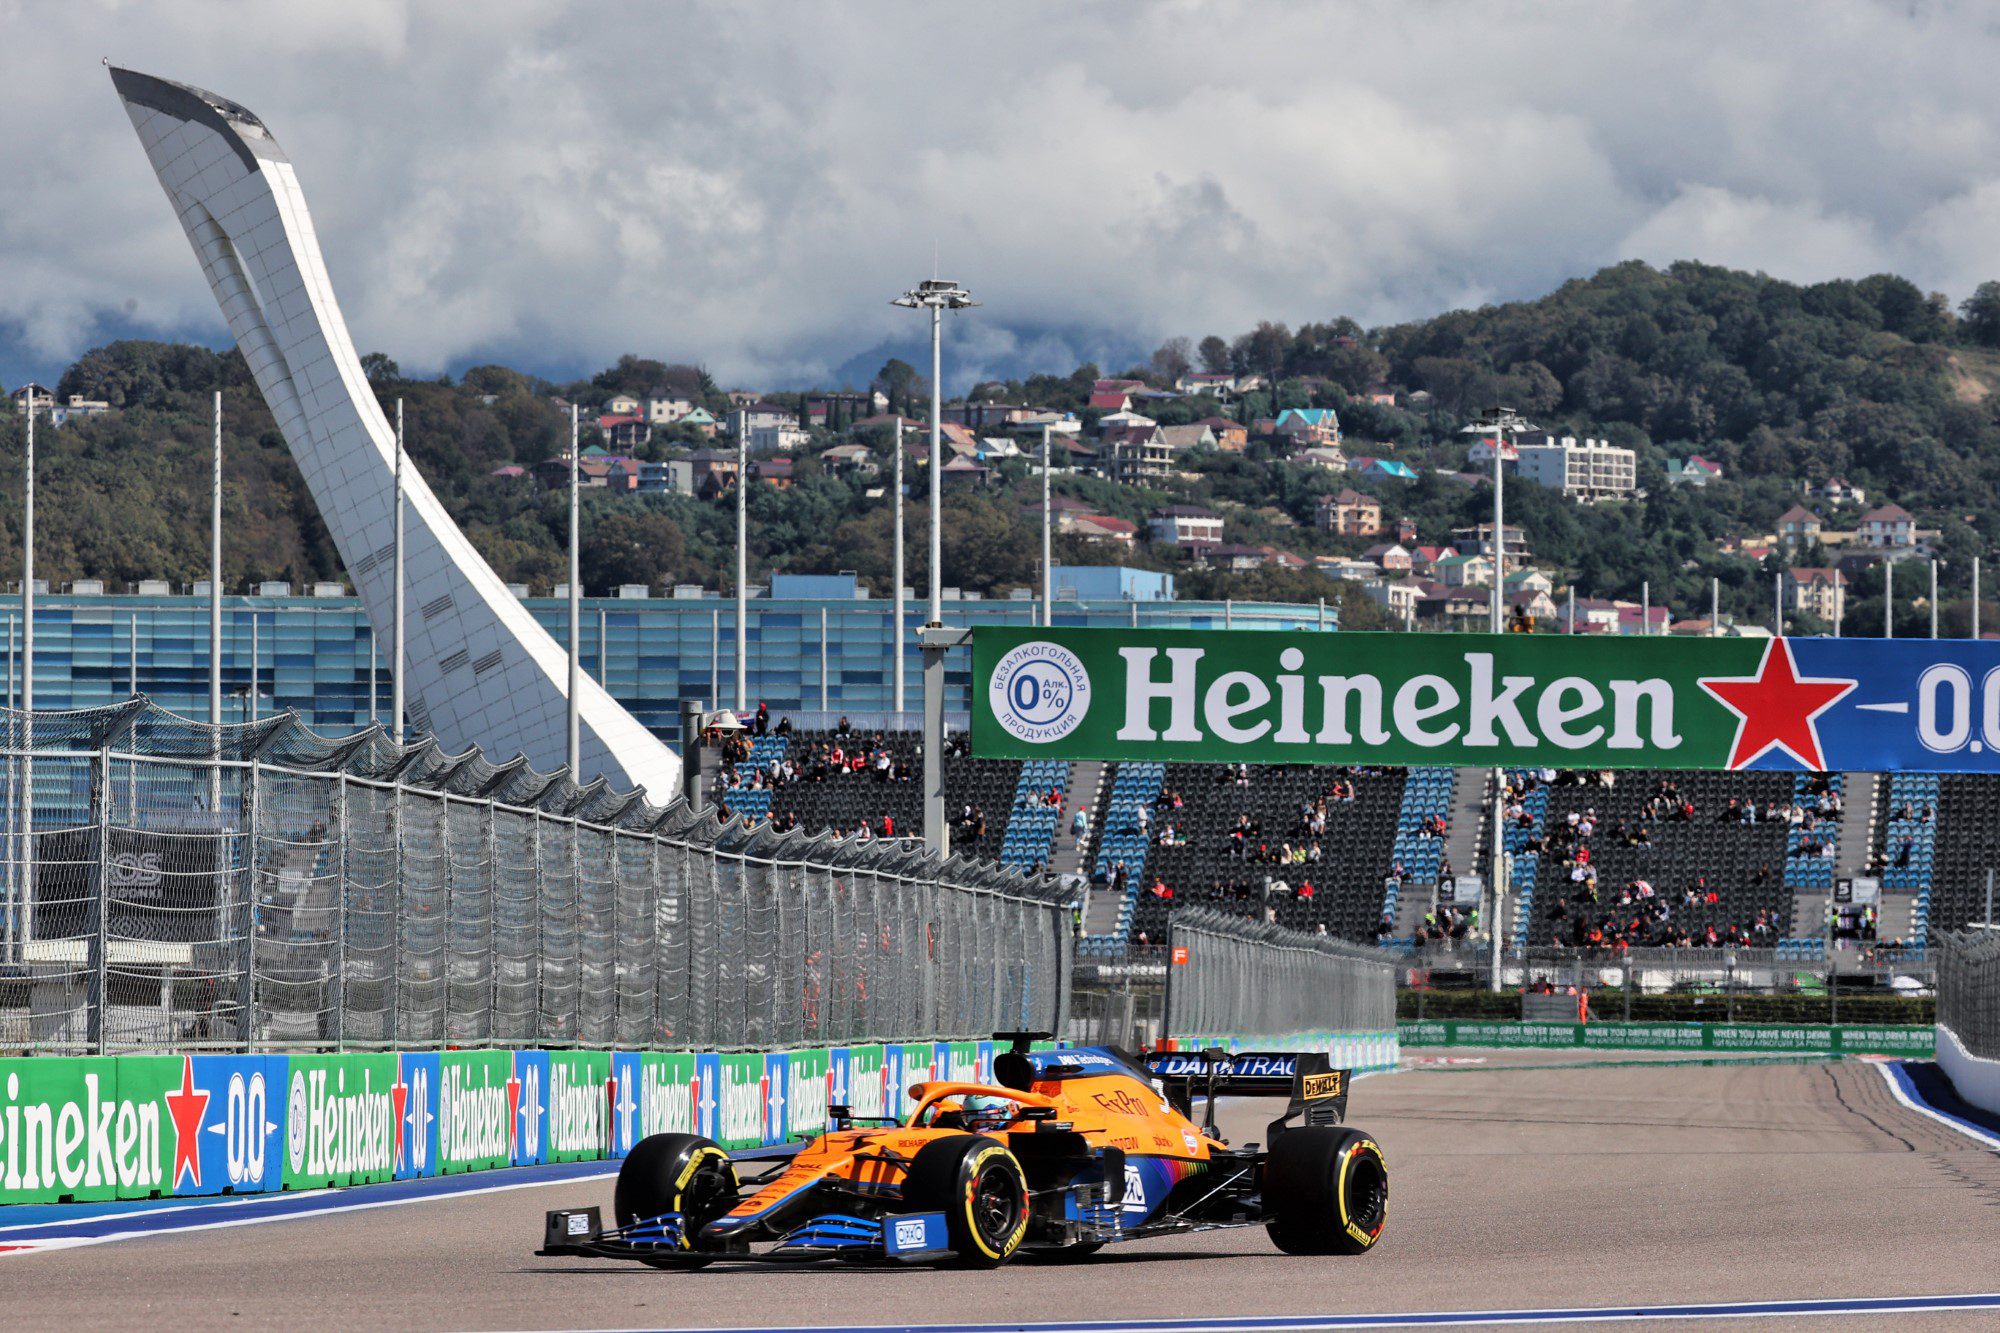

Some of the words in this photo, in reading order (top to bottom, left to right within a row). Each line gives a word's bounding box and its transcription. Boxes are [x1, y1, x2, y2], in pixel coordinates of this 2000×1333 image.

[994, 646, 1086, 692] БЕЗАЛКОГОЛЬНАЯ
[1042, 679, 1068, 688] Алк.
[1014, 674, 1040, 710] 0
[1042, 689, 1064, 708] %
[1116, 647, 1683, 750] Heineken
[1002, 713, 1077, 740] ПРОДУКЦИЯ
[1838, 881, 1850, 895] 5
[1174, 949, 1186, 962] F
[1712, 1029, 1737, 1038] WHEN
[1739, 1029, 1755, 1038] YOU
[1165, 1056, 1296, 1075] DARKTRAC
[451, 1062, 506, 1160] Heineken
[558, 1062, 606, 1152] Heineken
[1091, 1090, 1149, 1116] ExPro
[0, 1072, 162, 1189] ineken
[228, 1072, 266, 1184] 0.0
[307, 1067, 390, 1175] Heineken
